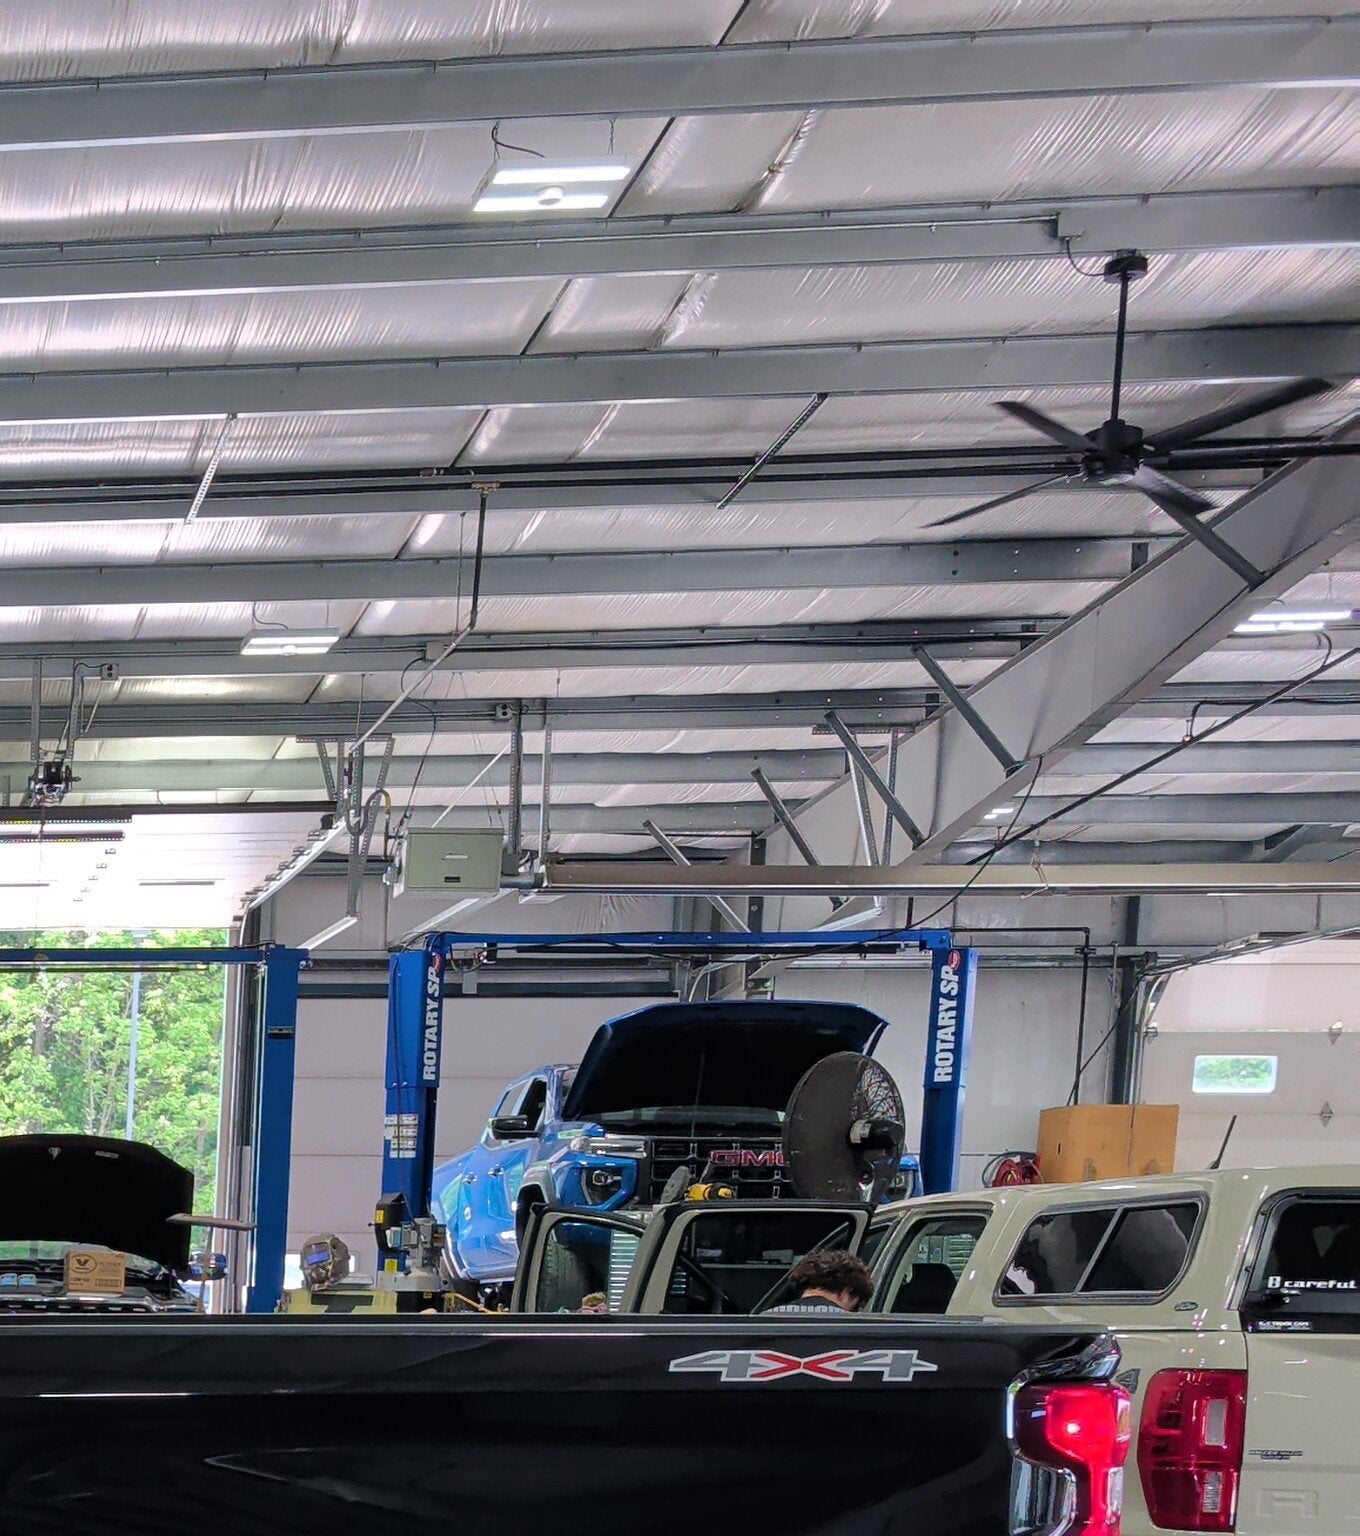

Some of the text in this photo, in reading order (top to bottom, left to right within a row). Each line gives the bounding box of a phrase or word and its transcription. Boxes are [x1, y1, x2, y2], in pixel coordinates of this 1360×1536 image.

[422, 966, 442, 1081] ROTARY SP
[933, 964, 960, 1083] ROTARY SP
[1283, 1280, 1358, 1289] careful
